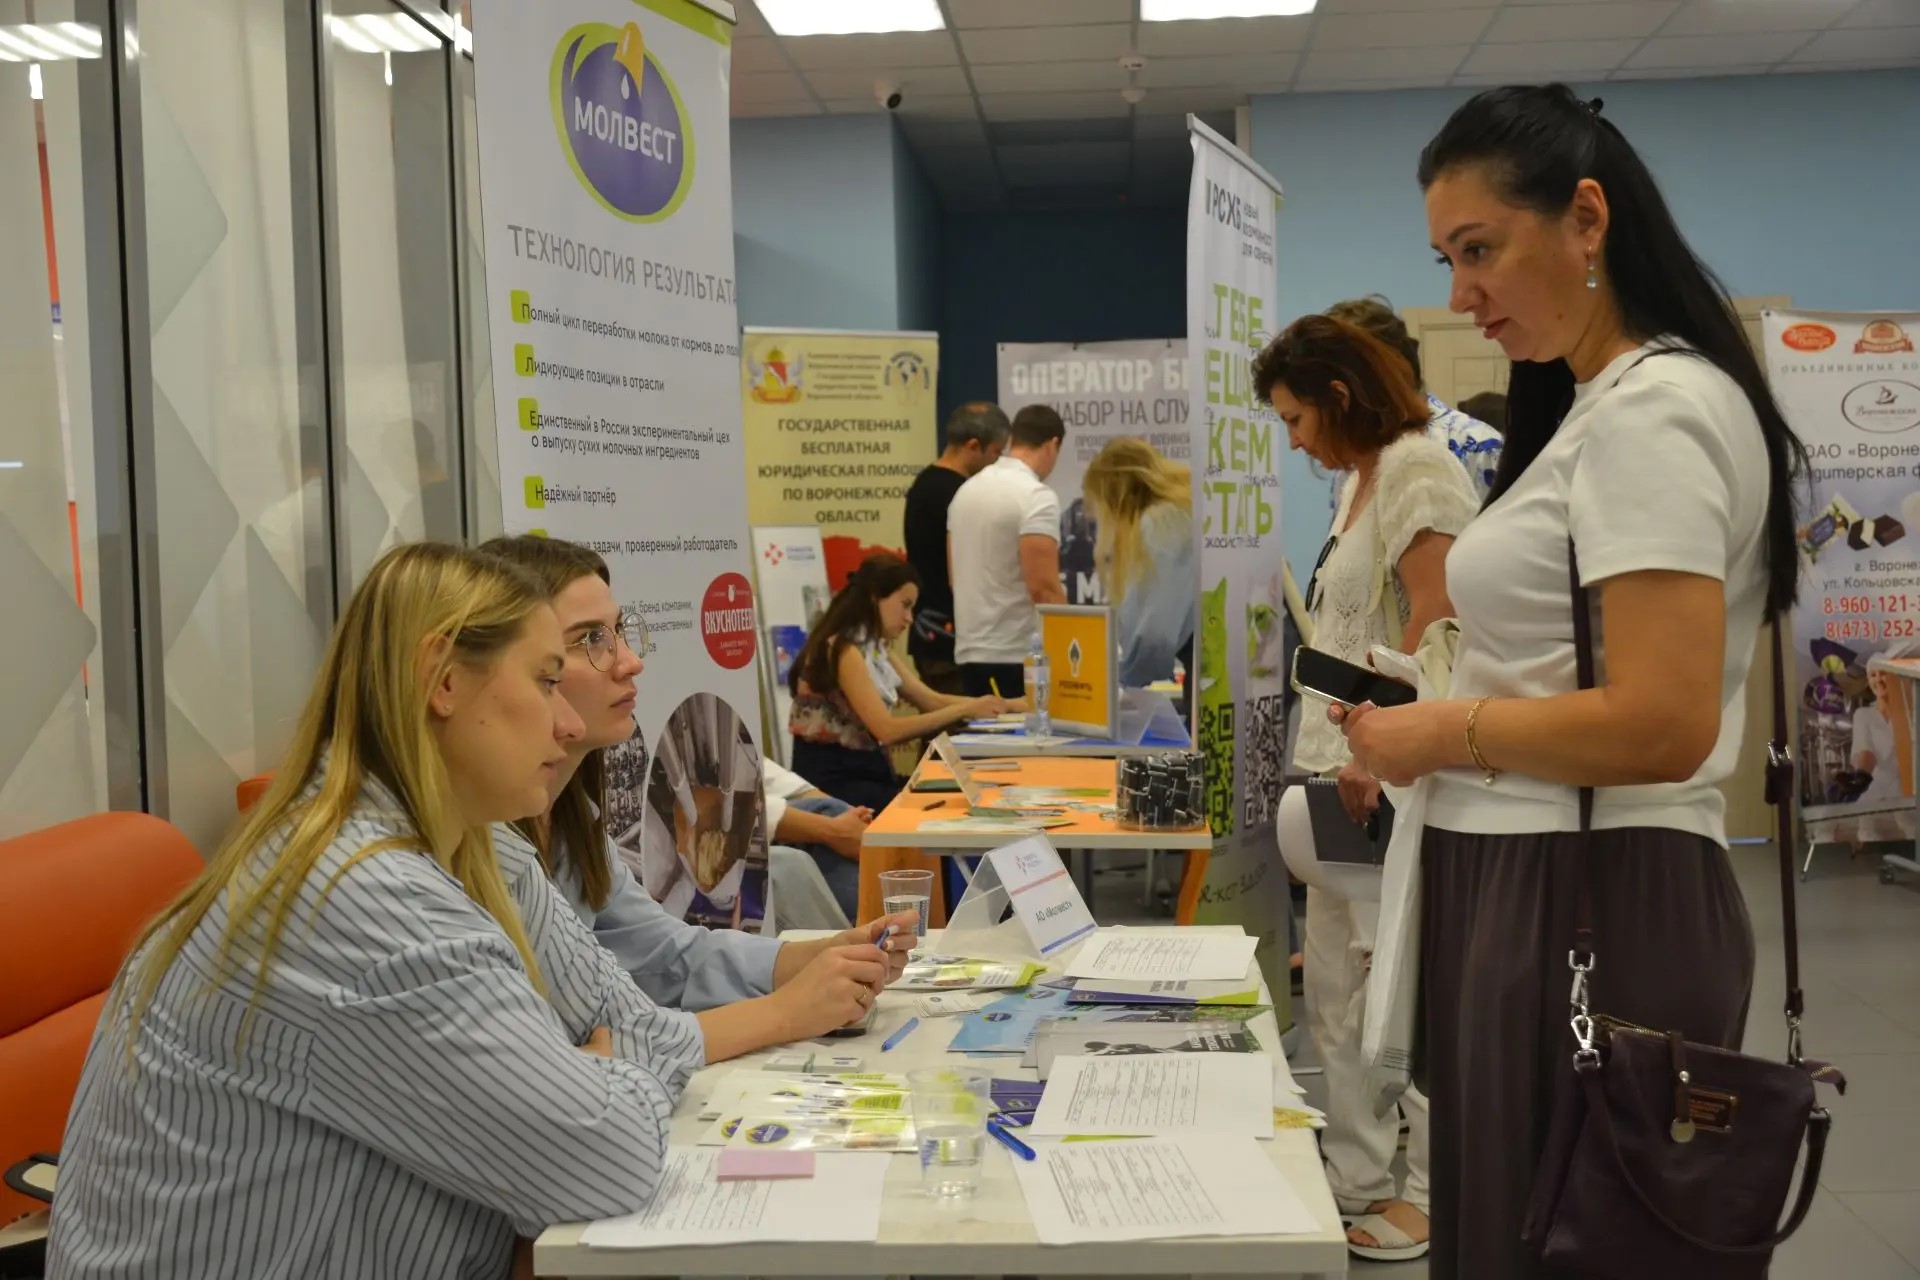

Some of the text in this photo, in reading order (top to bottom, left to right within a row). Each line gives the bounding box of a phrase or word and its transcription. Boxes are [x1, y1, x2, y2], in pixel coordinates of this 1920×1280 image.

[575, 97, 676, 164] МОЛВЕСТ
[507, 224, 636, 285] ТЕХНОЛОГИЯ
[522, 303, 560, 325] Полный
[562, 314, 580, 330] цикл
[582, 319, 636, 340] переработки
[638, 331, 669, 346] молока
[671, 336, 680, 347] от
[681, 338, 712, 354] кормов
[714, 343, 724, 355] до
[525, 357, 664, 392] Лидирующие позиции в отрасли
[1010, 359, 1152, 394] ОПЕРАТОР
[1120, 400, 1148, 425] НА
[1154, 398, 1190, 425] СЛУ
[529, 410, 730, 445] Единственный в России экспериментальный цех
[778, 418, 911, 434] ГОСУДАРСТВЕННАЯ
[542, 436, 576, 454] выпуску
[578, 439, 600, 455] сухих
[603, 442, 643, 457] молочных
[645, 445, 700, 460] ингредиентов
[801, 441, 891, 455] БЕСПЛАТНАЯ
[1208, 416, 1271, 474] КЕМ
[758, 463, 925, 480] ЮРИДИЧЕСКАЯ ПОМО
[535, 483, 616, 506] Надёжный партнёр
[783, 488, 803, 501] ПО
[816, 510, 880, 524] ОБЛАСТИ
[625, 536, 681, 555] проверенный
[683, 536, 738, 554] работодатель
[639, 600, 659, 613] бренд
[1826, 620, 1878, 641] 8(473)
